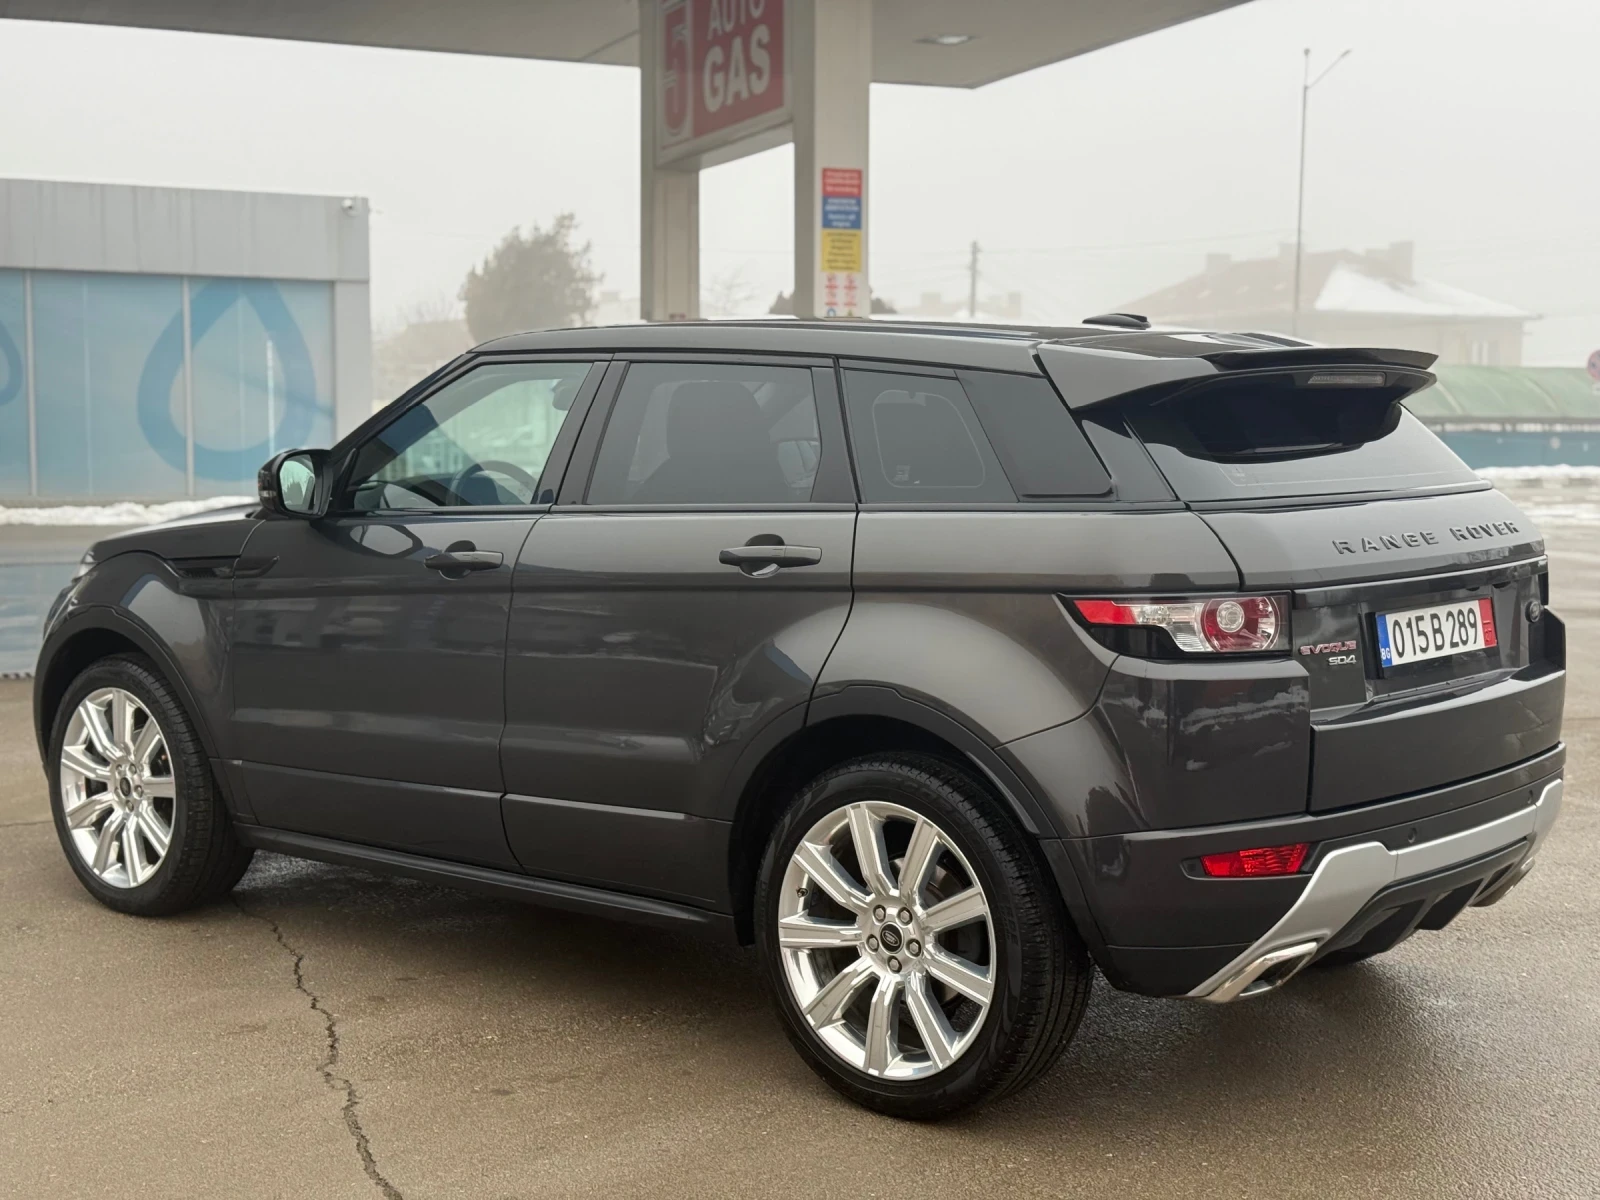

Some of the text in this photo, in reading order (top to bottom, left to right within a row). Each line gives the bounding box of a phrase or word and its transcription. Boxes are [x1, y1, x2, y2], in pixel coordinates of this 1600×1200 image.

[703, 23, 771, 113] GAS
[1332, 520, 1520, 555] RANGE ROVER
[1392, 607, 1478, 658] 015B289
[1299, 640, 1357, 656] EVOQUE
[1328, 654, 1357, 666] SD4
[1381, 647, 1391, 660] BG
